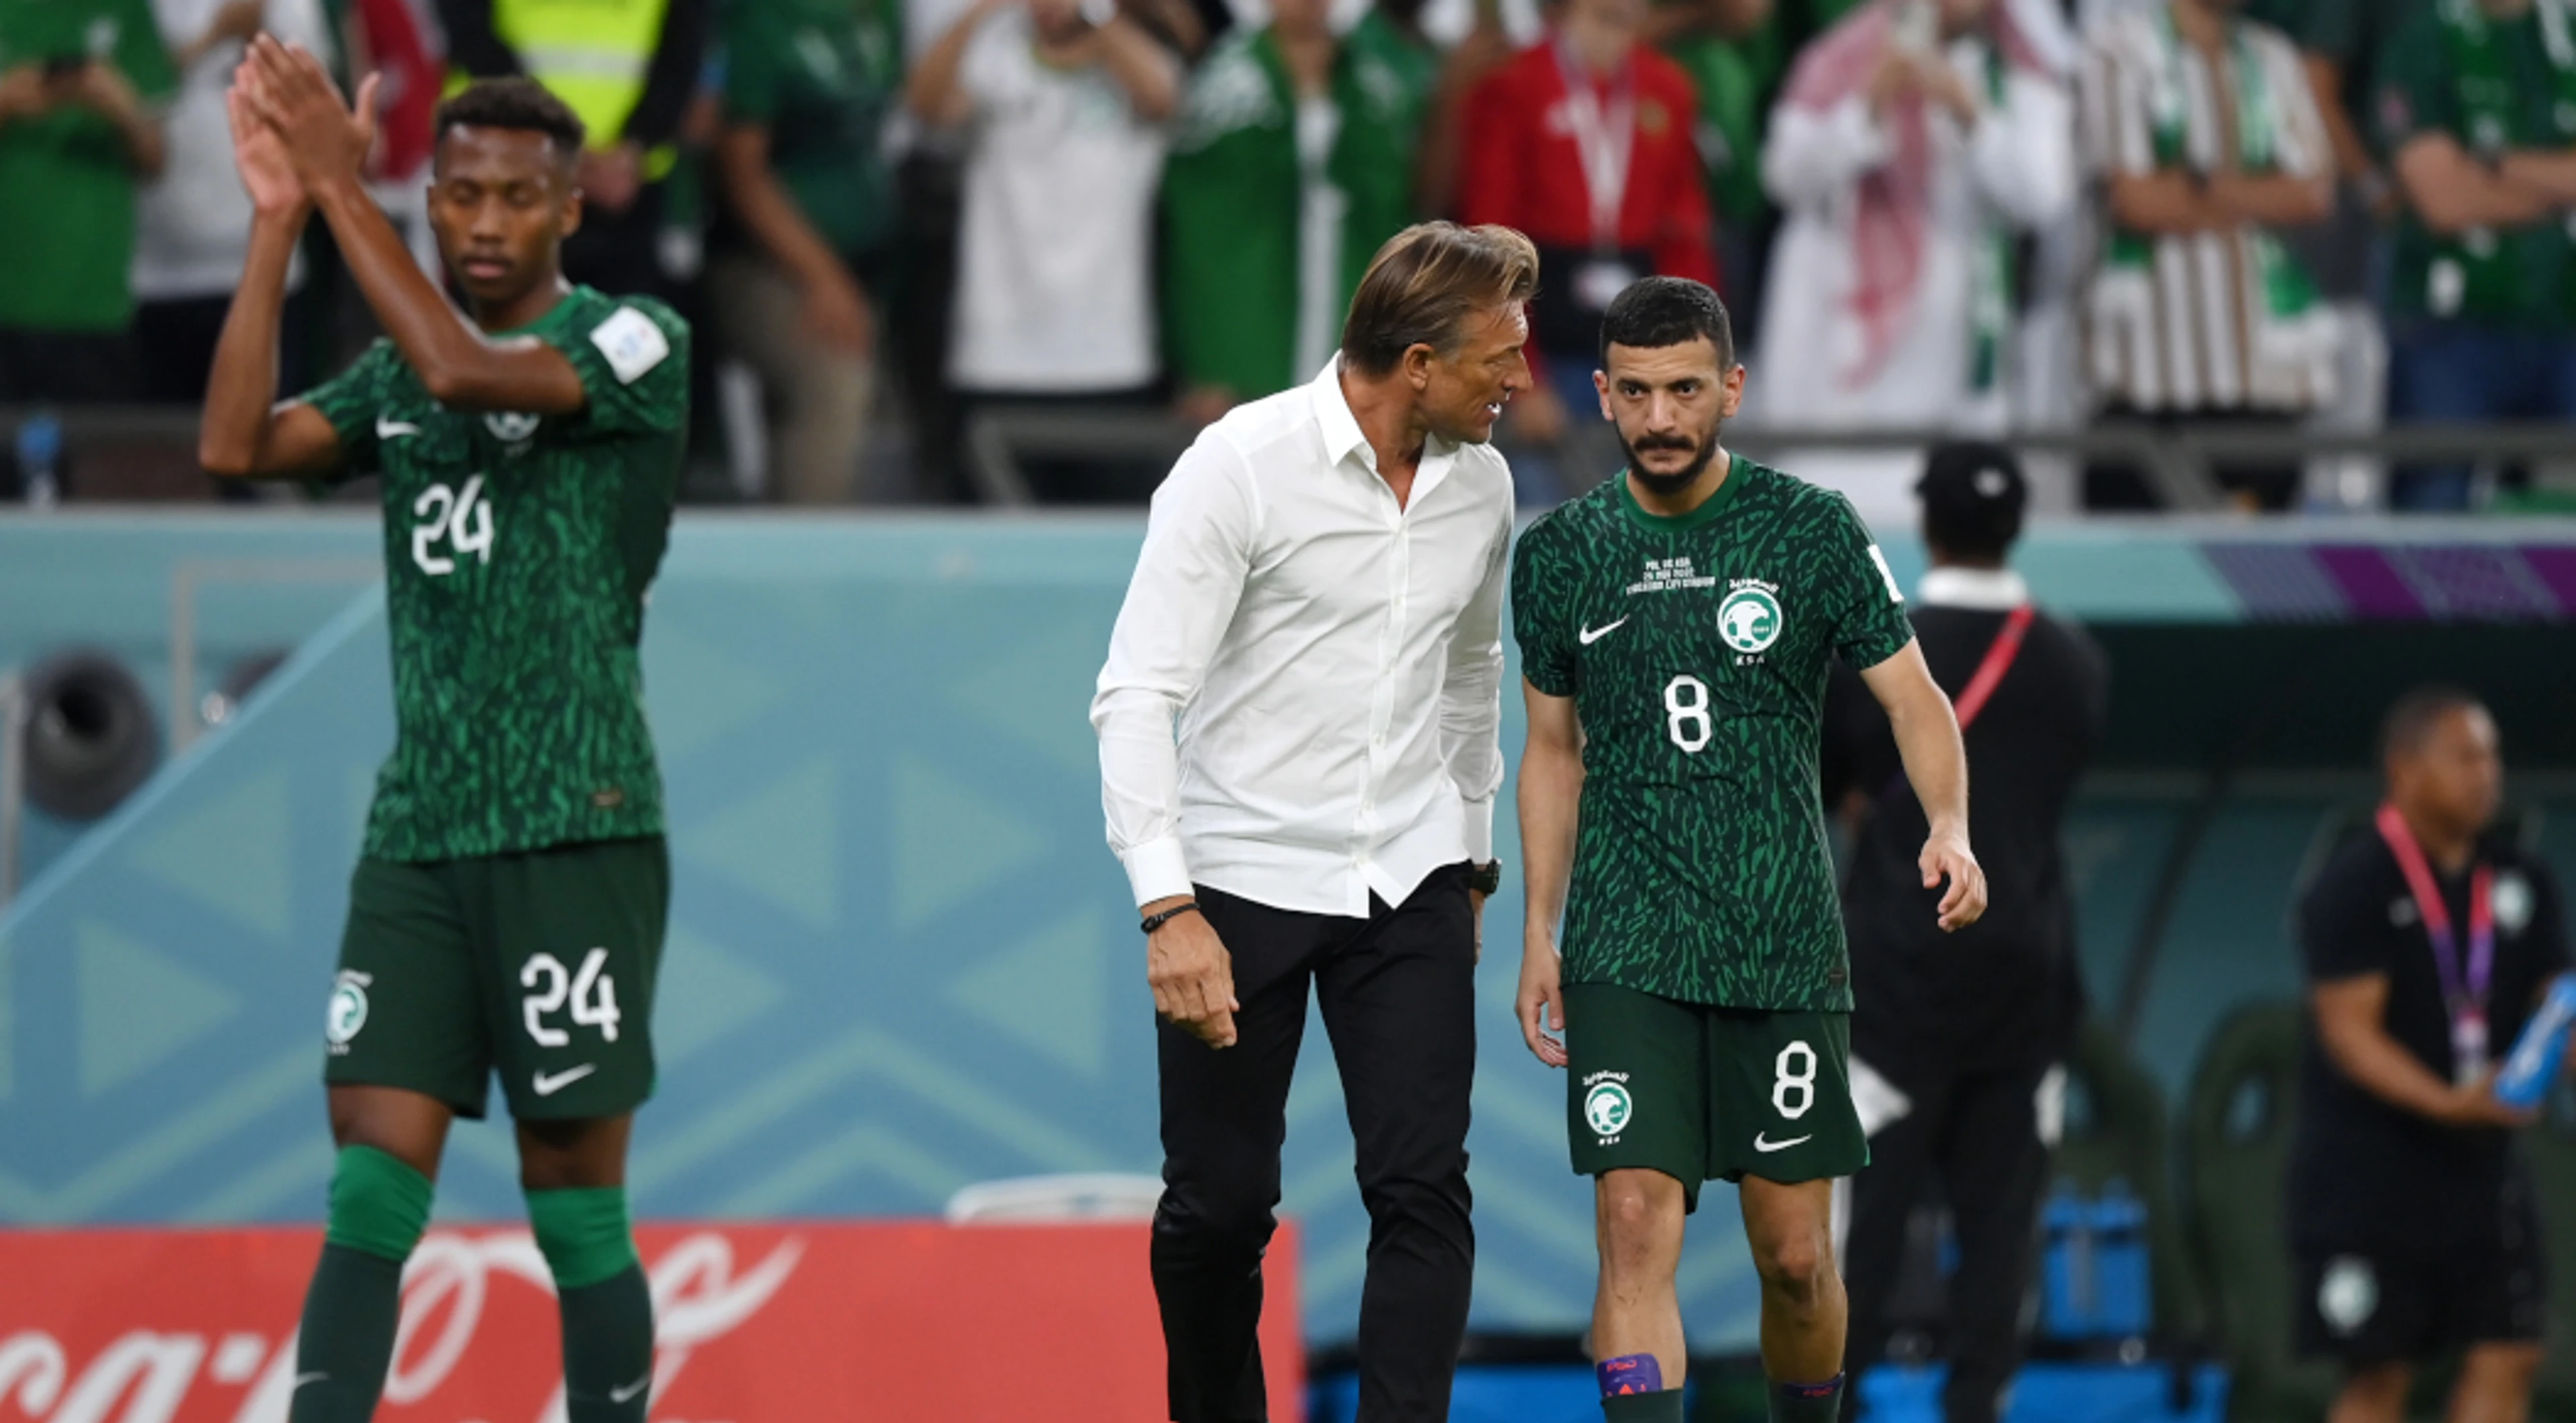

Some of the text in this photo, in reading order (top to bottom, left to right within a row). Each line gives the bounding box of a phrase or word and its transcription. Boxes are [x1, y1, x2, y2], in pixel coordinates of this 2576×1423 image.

[412, 474, 494, 576] 24
[1735, 655, 1766, 666] KSA
[1664, 674, 1712, 753] 8
[520, 947, 621, 1047] 24
[1772, 1041, 1817, 1120] 8
